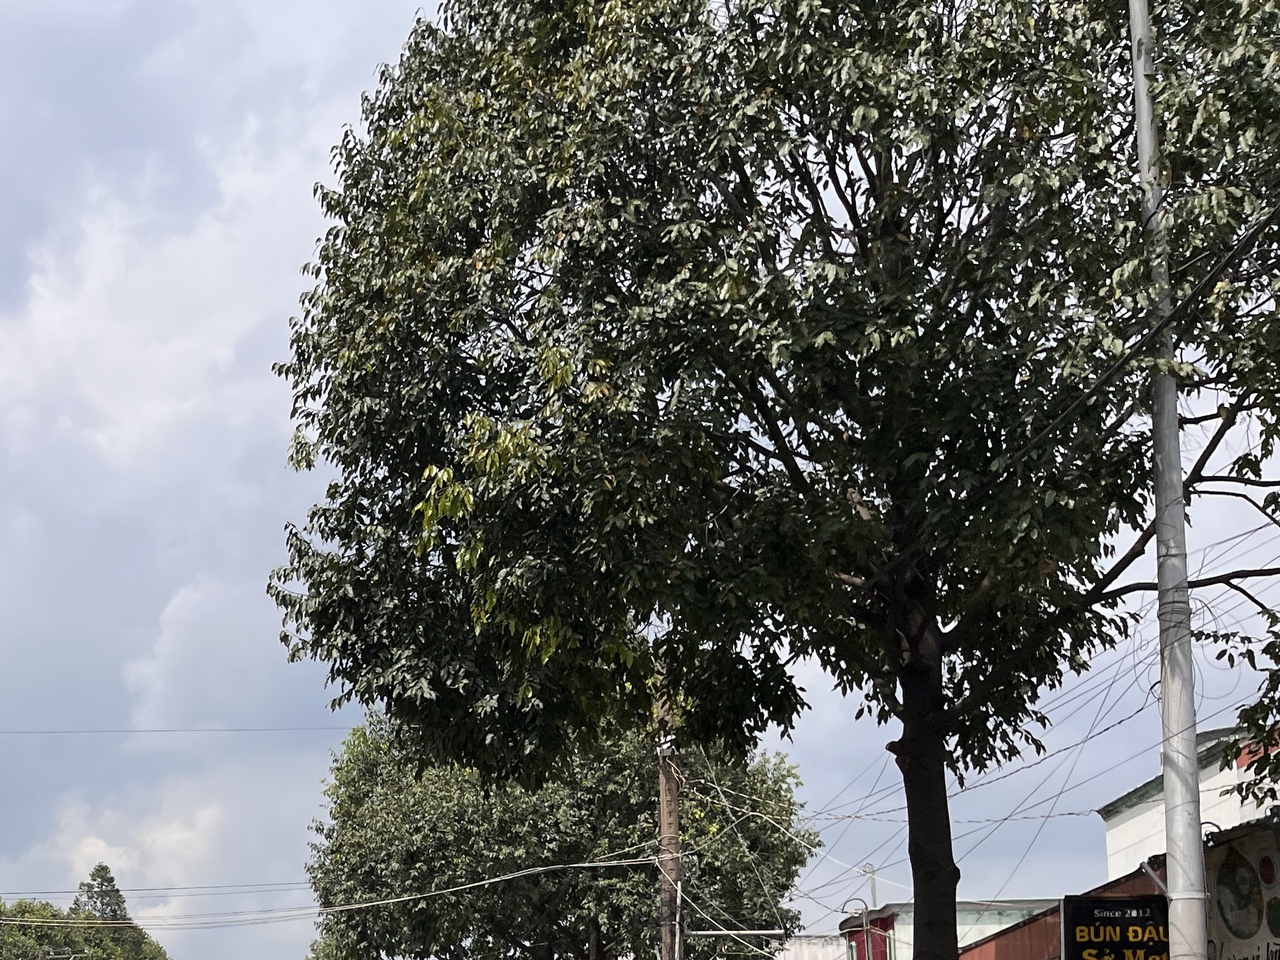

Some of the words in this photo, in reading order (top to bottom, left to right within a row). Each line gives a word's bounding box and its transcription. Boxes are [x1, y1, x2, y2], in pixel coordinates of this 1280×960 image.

[1093, 909, 1122, 918] Since
[1075, 921, 1121, 943] BÚN
[1126, 920, 1170, 946] ĐẬU
